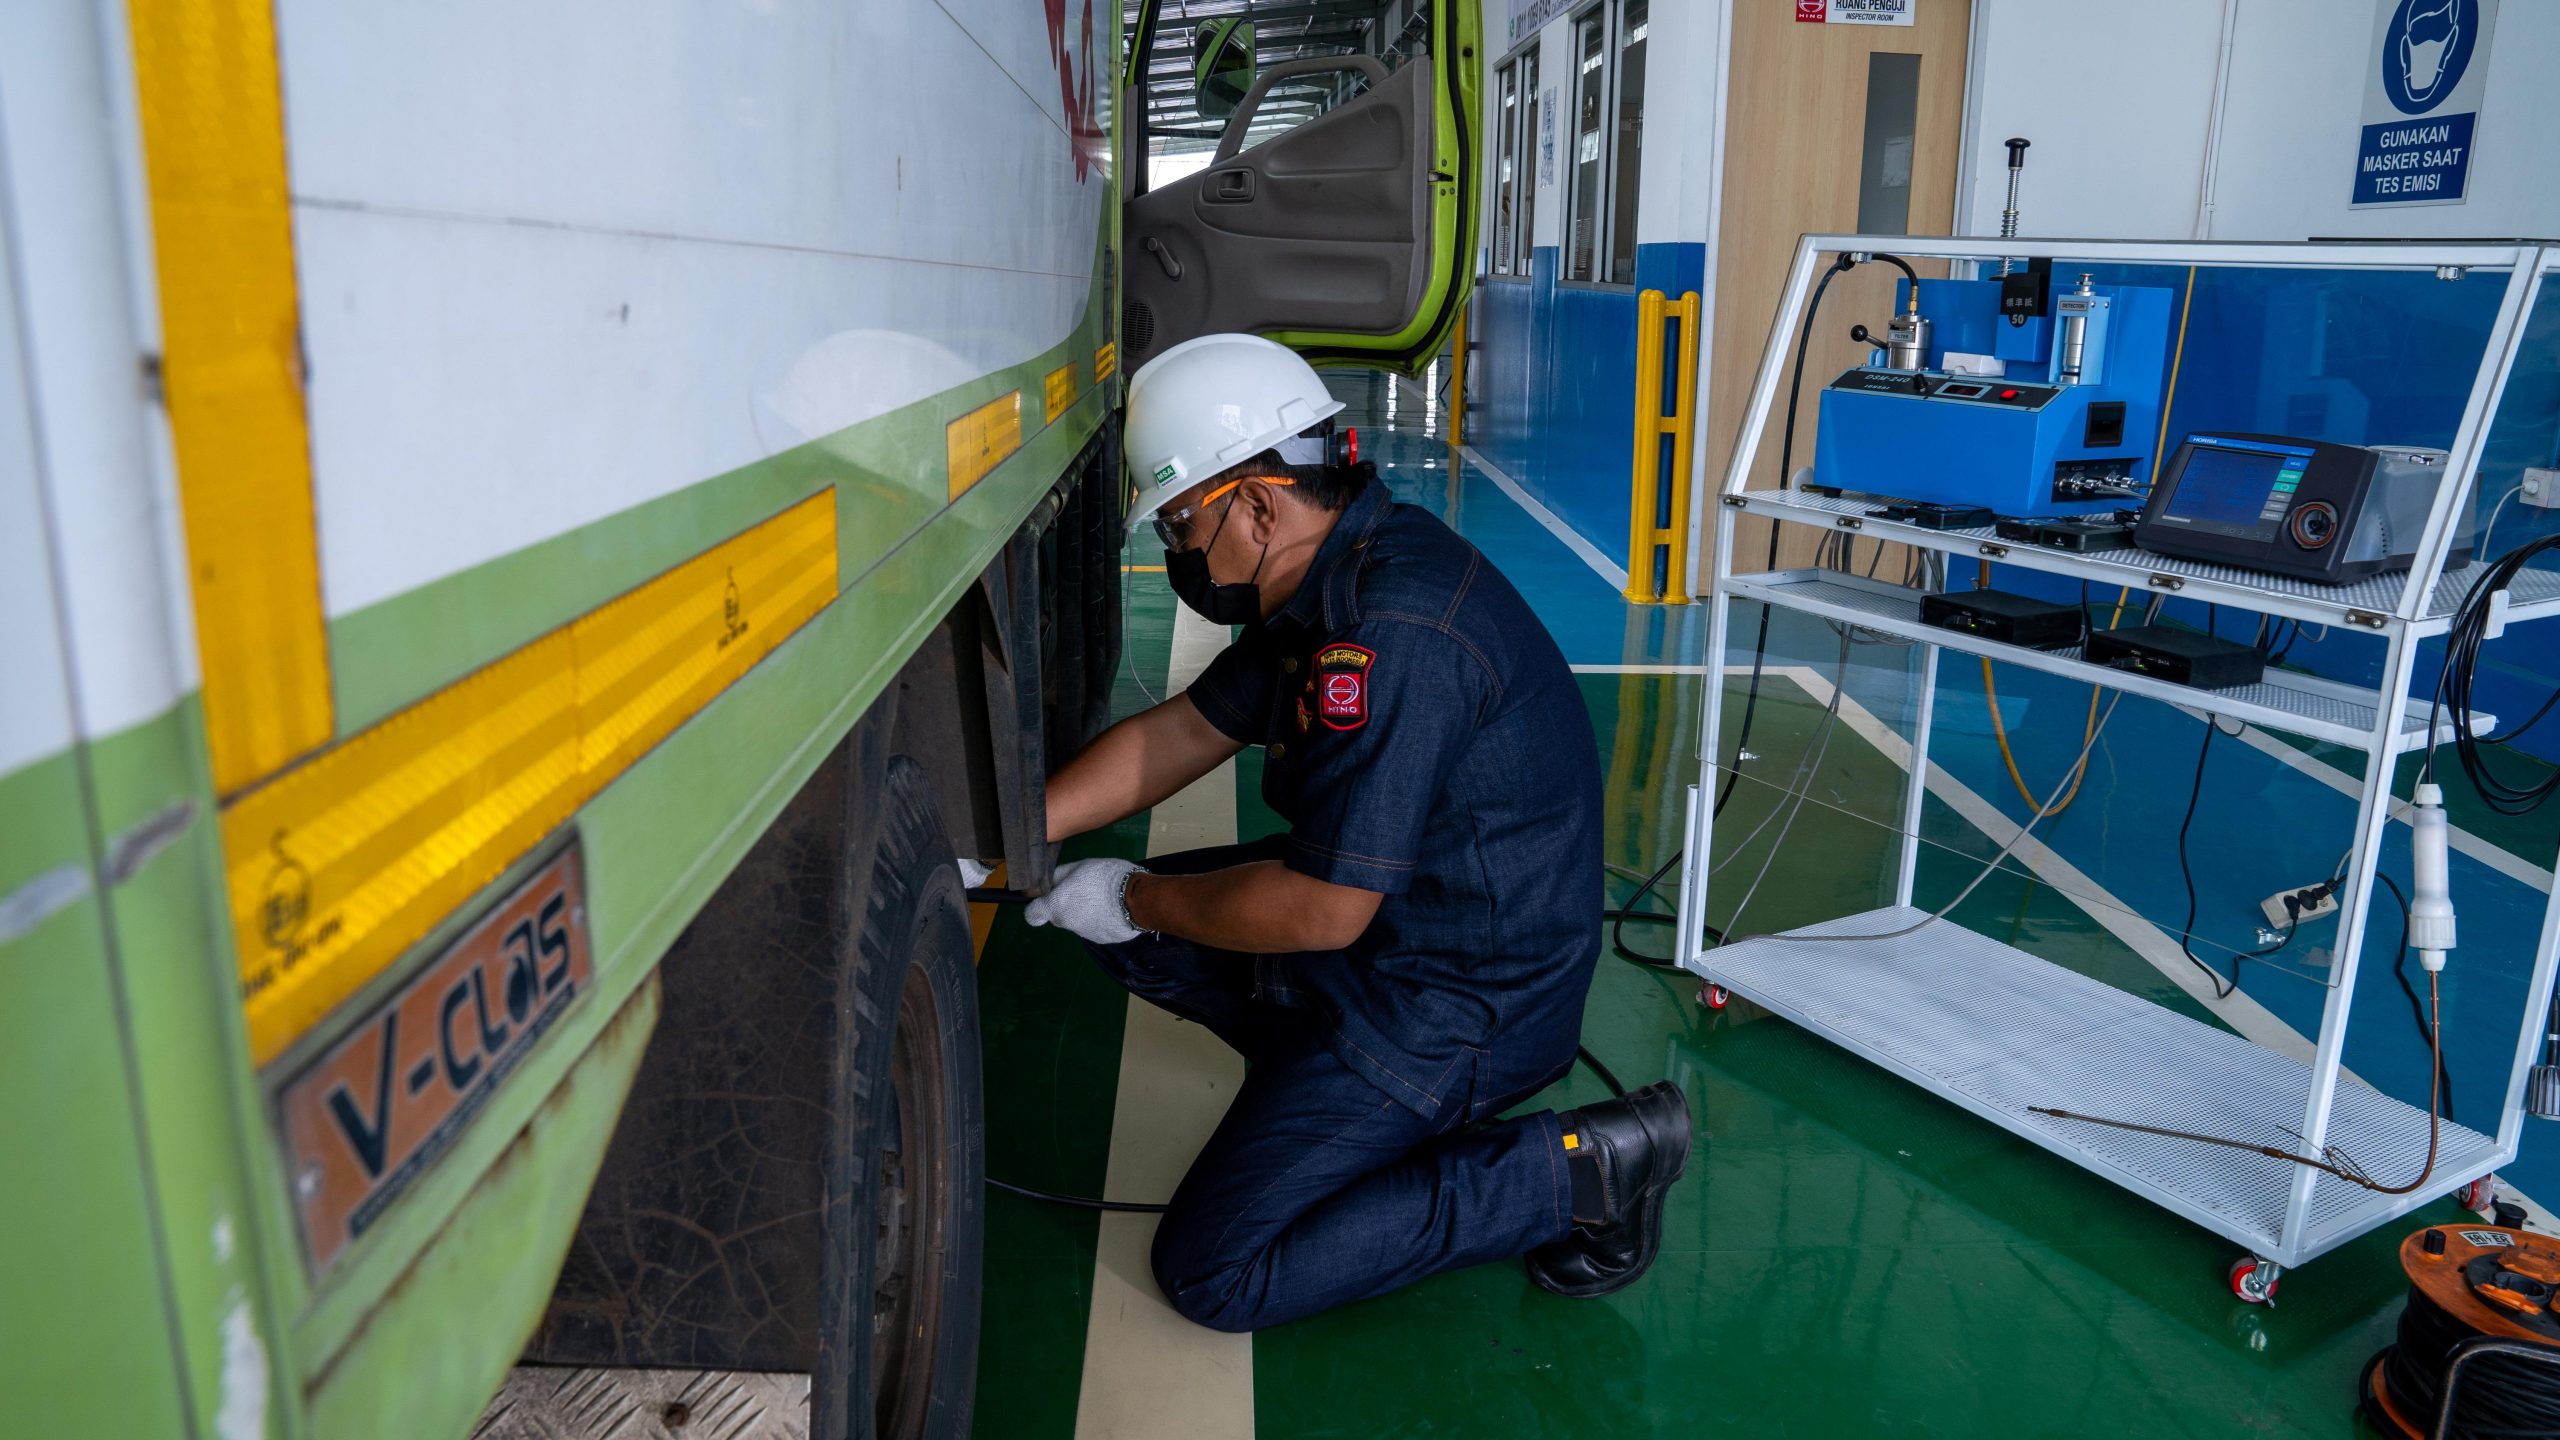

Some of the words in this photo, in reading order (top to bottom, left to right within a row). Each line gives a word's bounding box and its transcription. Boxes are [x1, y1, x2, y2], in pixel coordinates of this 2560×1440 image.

[1868, 0, 1905, 12] PENGUJI
[1845, 12, 1876, 21] INSPECTOR
[1877, 13, 1895, 22] ROOM
[2379, 125, 2450, 148] GUNAKAN
[2363, 152, 2419, 173] MASKER
[2422, 148, 2463, 167] SAAT
[2375, 177, 2400, 194] TES
[2402, 173, 2441, 193] EMISI
[2011, 313, 2025, 325] 50
[2192, 436, 2218, 444] HORIBA
[1156, 467, 1174, 481] MSA
[1337, 650, 1363, 659] MOTORS
